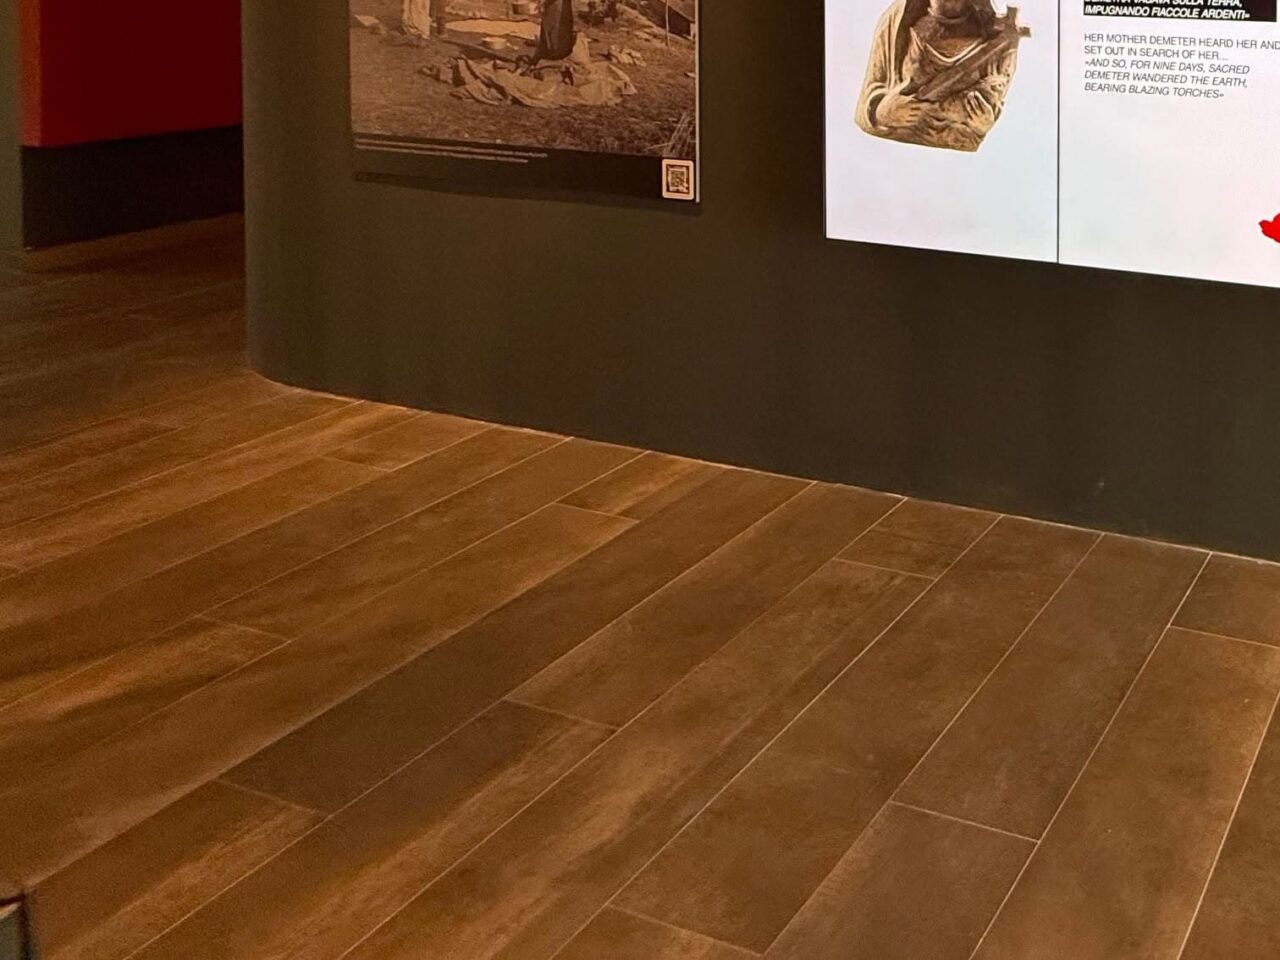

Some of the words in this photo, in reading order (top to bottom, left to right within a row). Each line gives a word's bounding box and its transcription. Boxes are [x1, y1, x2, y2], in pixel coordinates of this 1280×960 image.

[1085, 5, 1150, 16] IMPUGNANDO
[1151, 7, 1200, 18] FIACCOLE
[1084, 33, 1104, 42] HER
[1106, 34, 1147, 44] MOTHER
[1149, 35, 1196, 46] DEMETER
[1198, 38, 1234, 48] HEARD
[1236, 40, 1257, 49] HER
[1084, 45, 1102, 54] SET
[1104, 46, 1125, 56] OUT
[1127, 47, 1137, 56] IN
[1139, 48, 1179, 58] SEARCH
[1181, 49, 1196, 59] OF
[1111, 59, 1128, 69] SO,
[1130, 60, 1151, 69] FOR
[1153, 61, 1176, 70] NINE
[1178, 62, 1206, 73] DAYS,
[1208, 64, 1250, 74] SACRED
[1085, 70, 1130, 81] DEMETER
[1132, 72, 1188, 83] WANDERED
[1191, 76, 1210, 85] THE
[1211, 77, 1248, 89] EARTH,
[1084, 82, 1127, 93] BEARING
[1128, 85, 1170, 96] BLAZING
